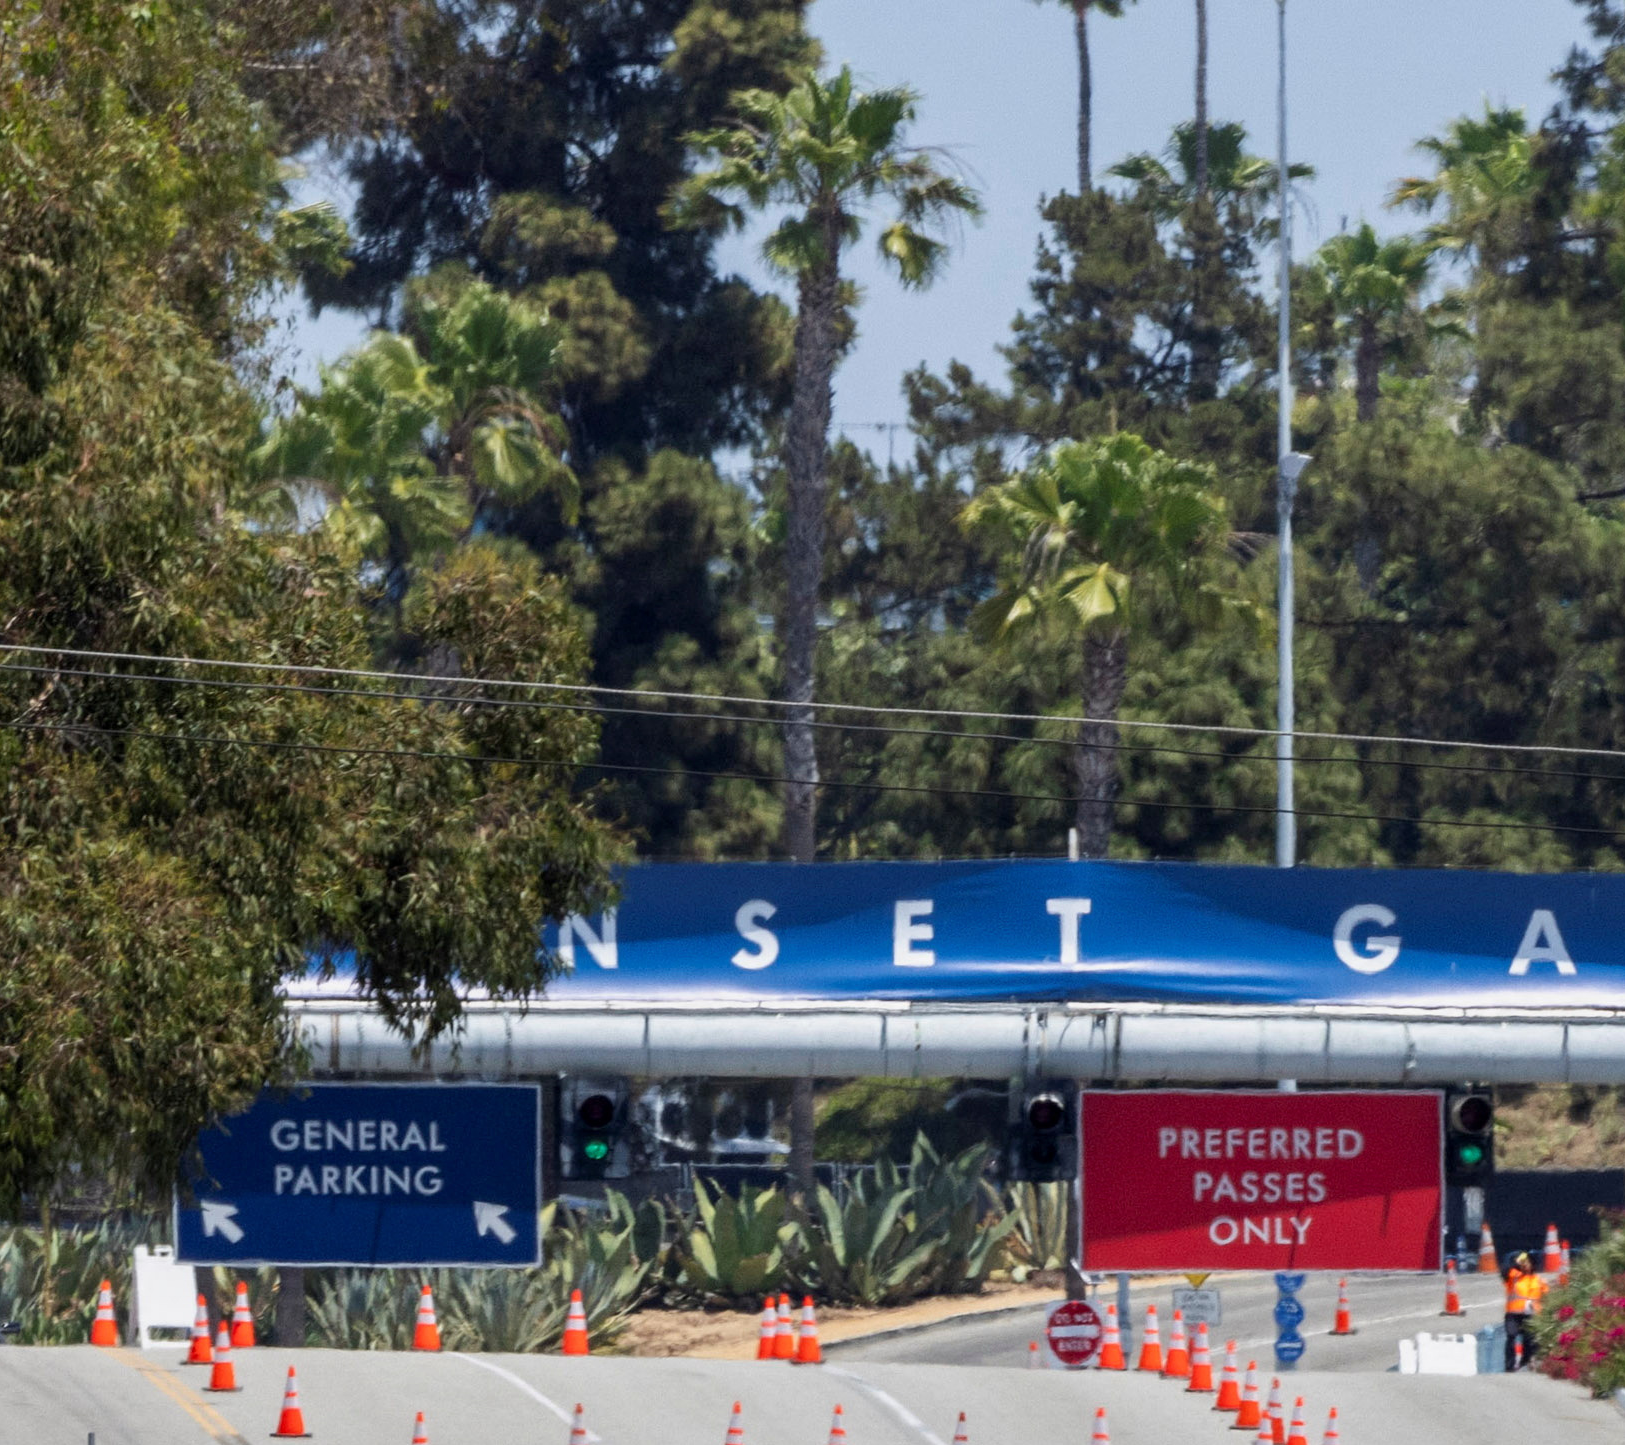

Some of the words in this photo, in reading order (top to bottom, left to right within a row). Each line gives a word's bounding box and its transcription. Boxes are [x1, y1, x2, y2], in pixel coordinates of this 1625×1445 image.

[270, 1119, 446, 1152] GENERAL
[1157, 1127, 1365, 1160] PREFERRED
[274, 1164, 444, 1196] PARKING
[1193, 1171, 1327, 1204] PASSES
[1207, 1215, 1313, 1247] ONLY
